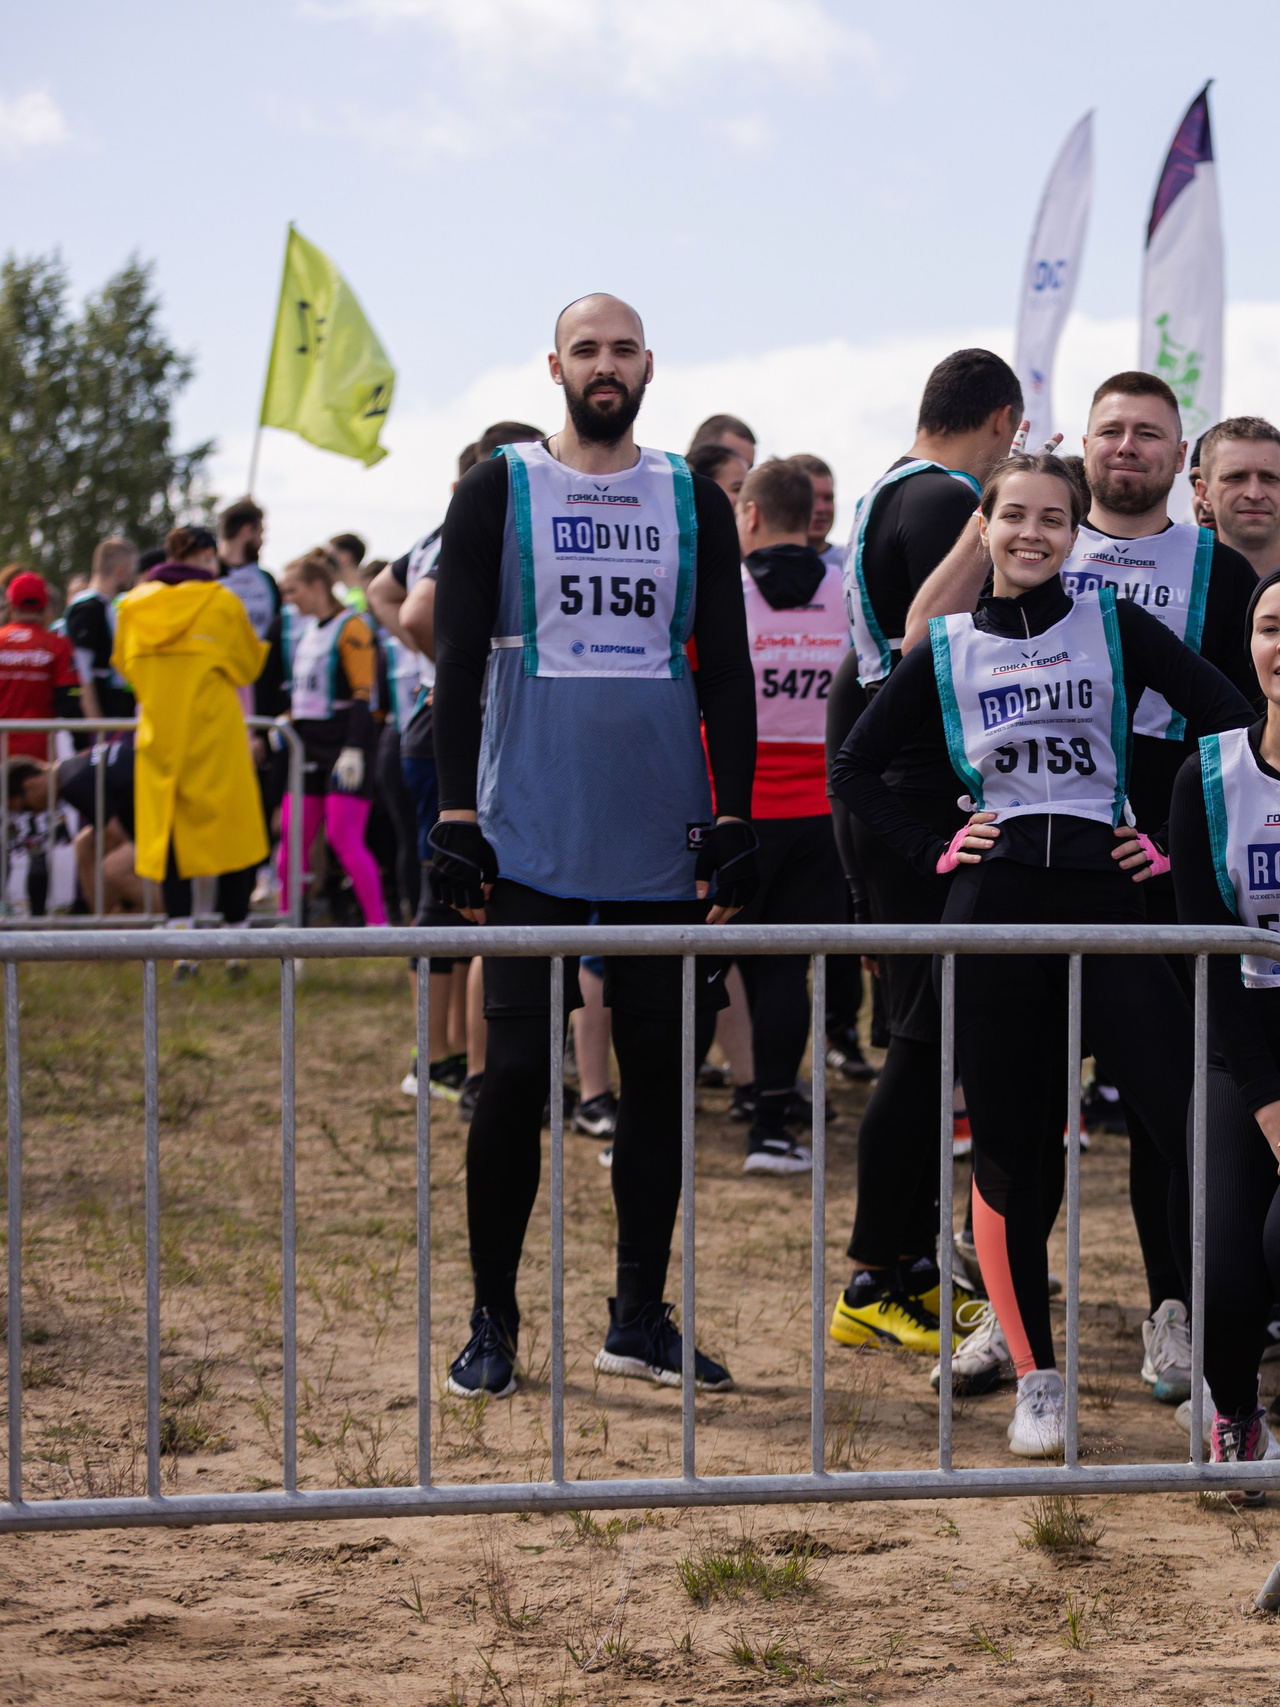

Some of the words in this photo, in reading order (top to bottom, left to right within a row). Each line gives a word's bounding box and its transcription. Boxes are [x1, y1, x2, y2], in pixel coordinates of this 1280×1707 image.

[567, 493, 599, 503] ГОНКА
[601, 494, 639, 504] ГЕРОЕВ
[555, 521, 661, 552] RODVIG
[1083, 552, 1116, 563] ГОНКА
[1117, 556, 1156, 566] ГЕРОЕВ
[560, 574, 657, 618] 5156
[589, 643, 647, 655] ГАЗПРОМБАНК
[993, 662, 1028, 674] ГОНКА
[1030, 651, 1069, 667] ГЕРОЕВ
[762, 668, 832, 699] 5472
[984, 678, 1093, 726] RODVIG
[994, 736, 1098, 776] 5159
